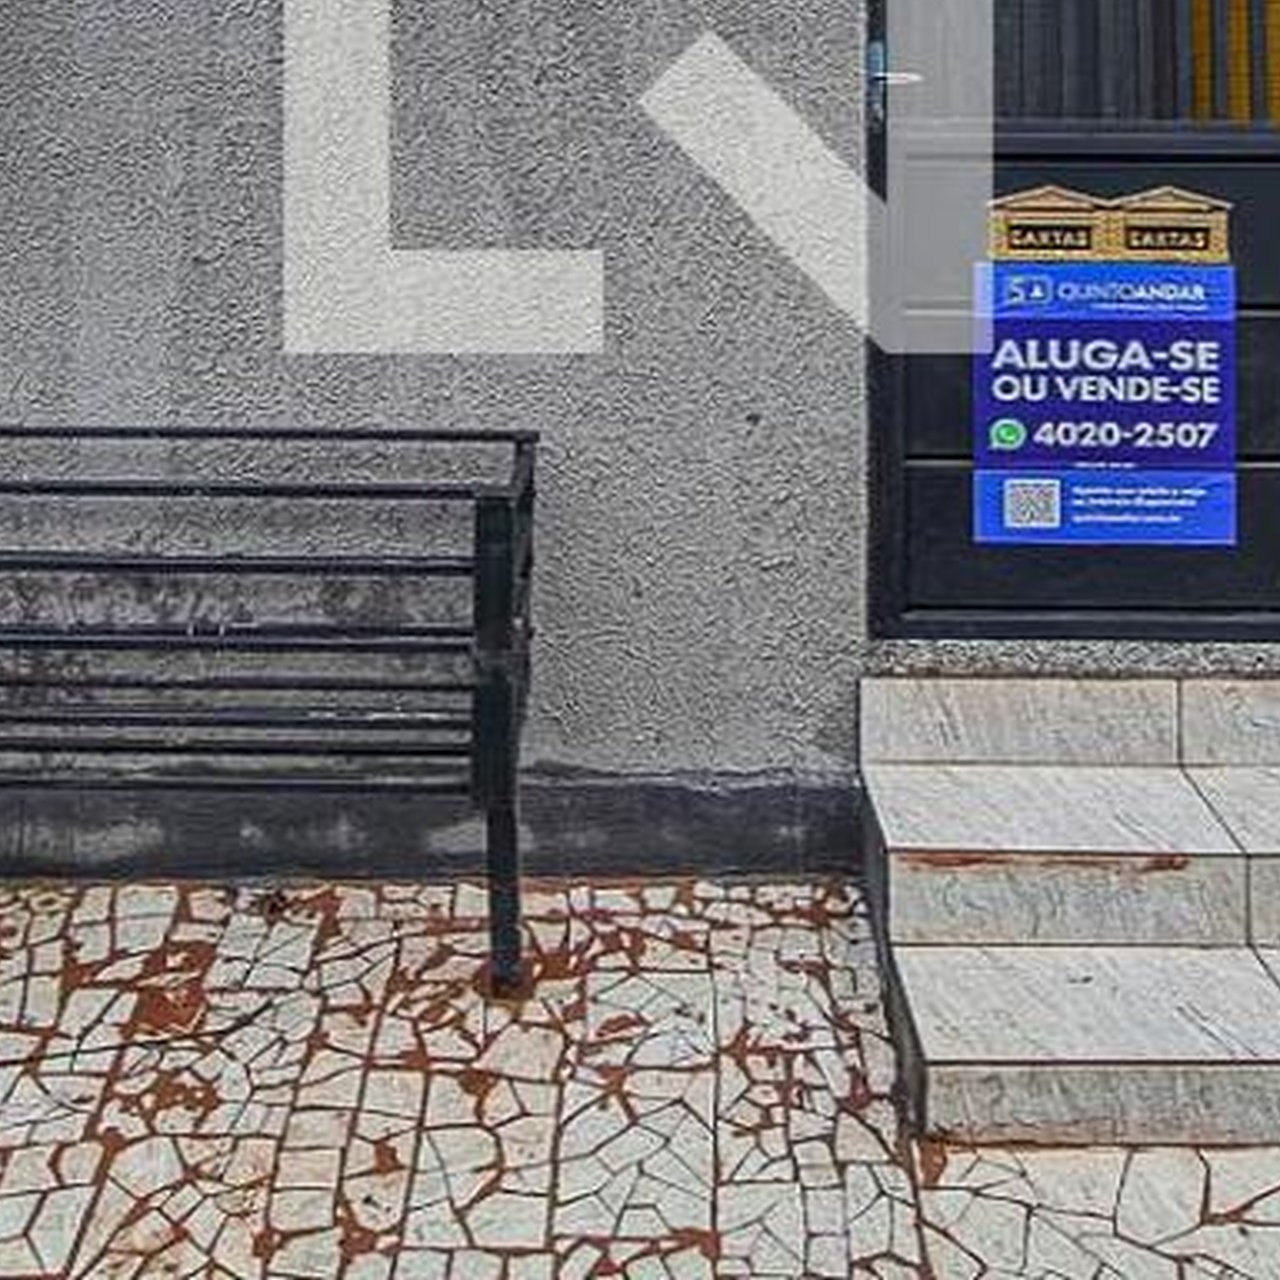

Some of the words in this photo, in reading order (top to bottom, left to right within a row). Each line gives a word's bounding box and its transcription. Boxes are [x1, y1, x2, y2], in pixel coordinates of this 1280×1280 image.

[1011, 228, 1088, 247] CARTAS
[1129, 231, 1206, 250] CARTAS
[992, 339, 1220, 371] ALUGA-SE
[992, 374, 1048, 402] OU
[1054, 375, 1221, 404] VENDE-SE
[1033, 422, 1219, 448] 4020-2507
